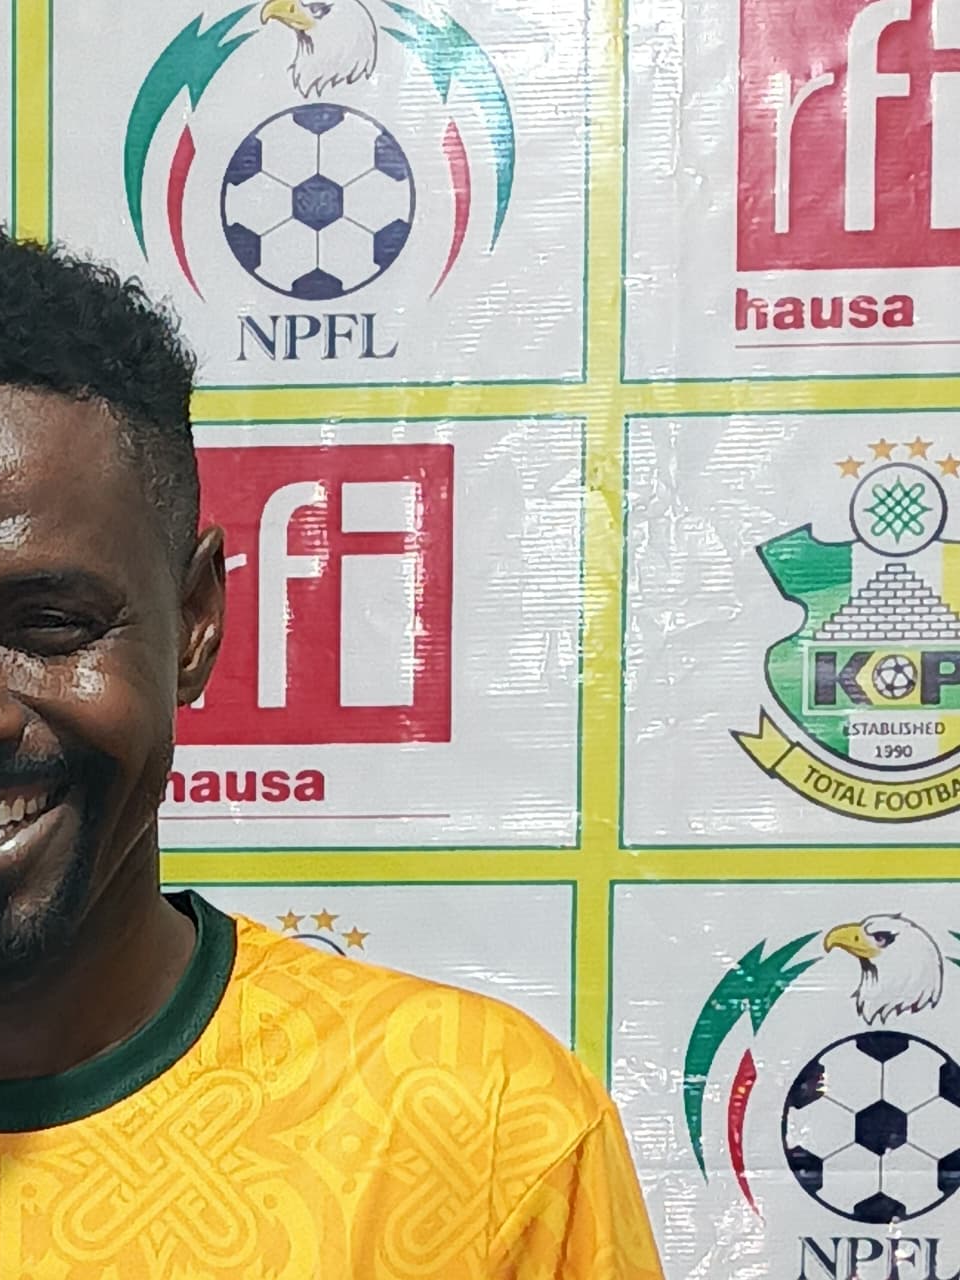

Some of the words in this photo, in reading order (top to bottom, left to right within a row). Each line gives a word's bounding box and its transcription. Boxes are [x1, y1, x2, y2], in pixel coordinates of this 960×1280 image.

[735, 287, 914, 330] hausa
[237, 312, 399, 361] NPFL
[191, 481, 416, 709] fi
[875, 744, 913, 758] 1990
[802, 764, 867, 808] TOTAL
[873, 777, 960, 812] FOOTBA
